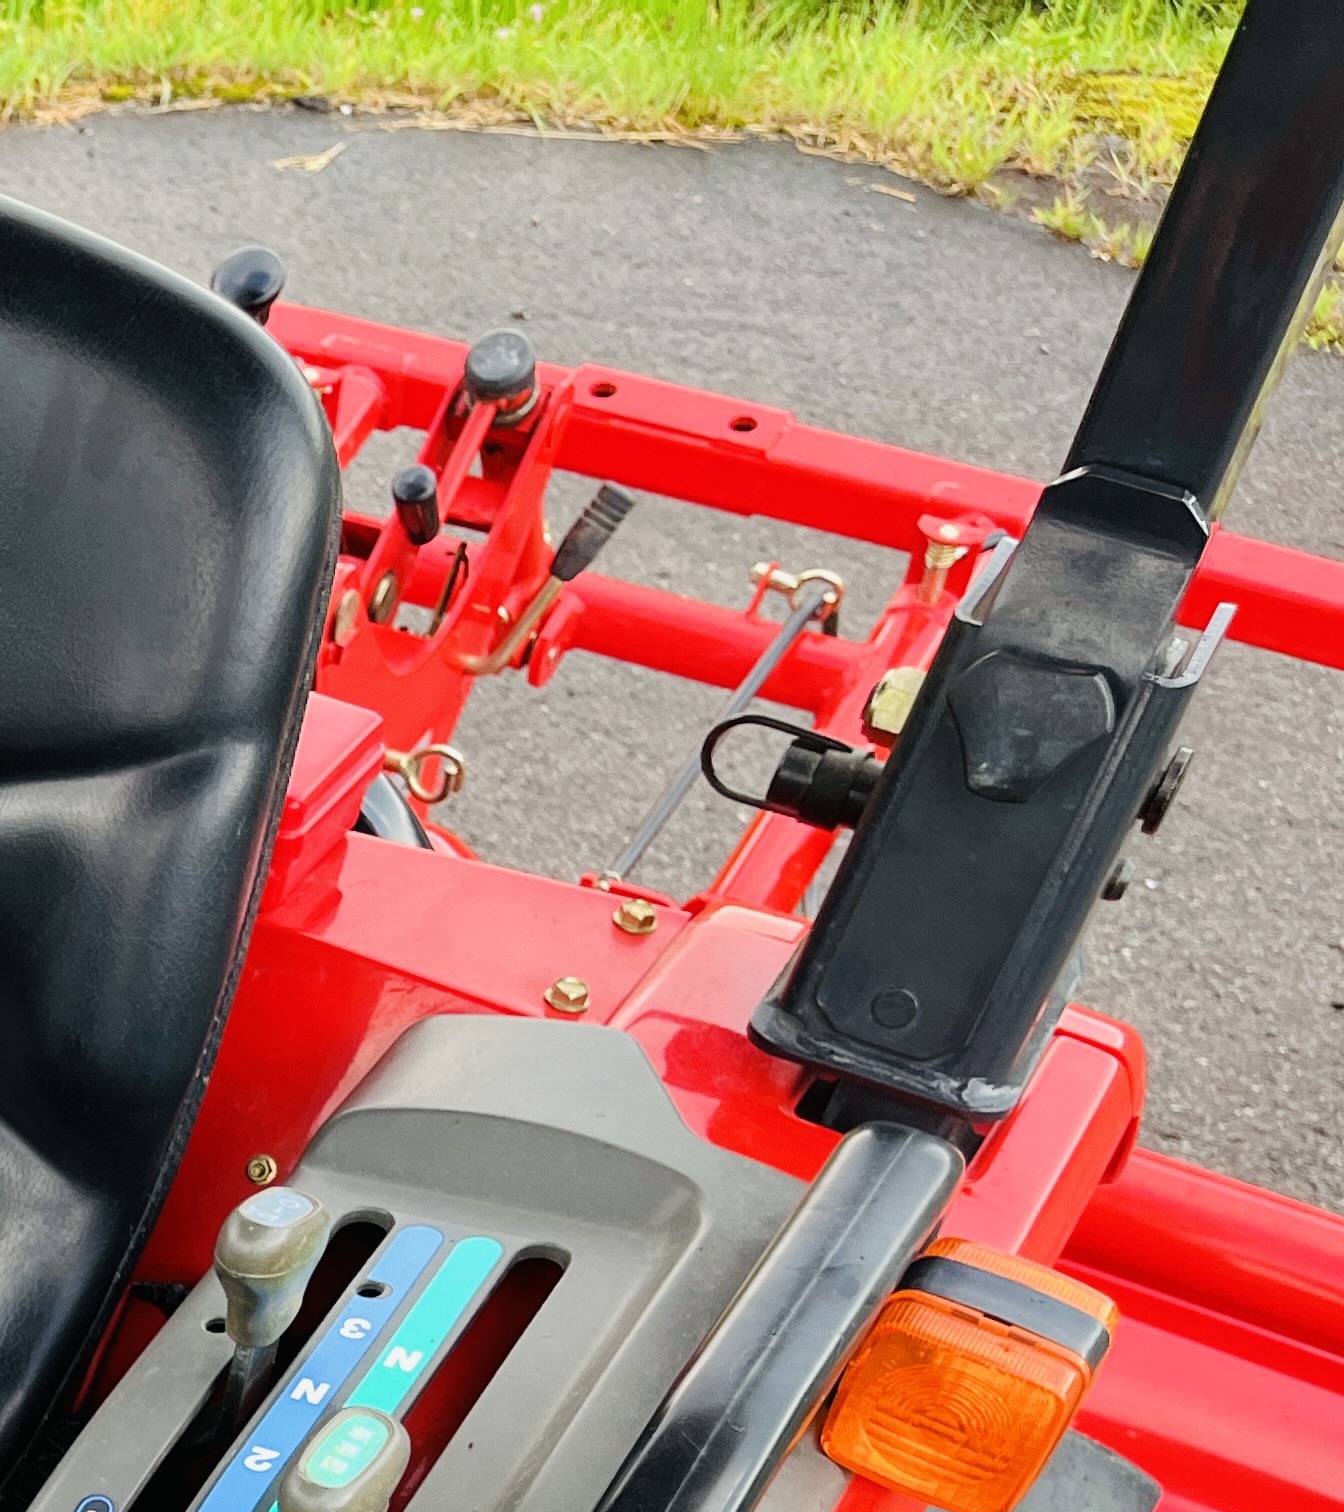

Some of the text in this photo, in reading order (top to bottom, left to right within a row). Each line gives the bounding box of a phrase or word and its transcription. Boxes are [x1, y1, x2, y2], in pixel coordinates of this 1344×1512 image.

[341, 1317, 372, 1340] 3
[385, 1345, 423, 1371] N
[291, 1380, 330, 1405] N
[243, 1447, 280, 1472] 2
